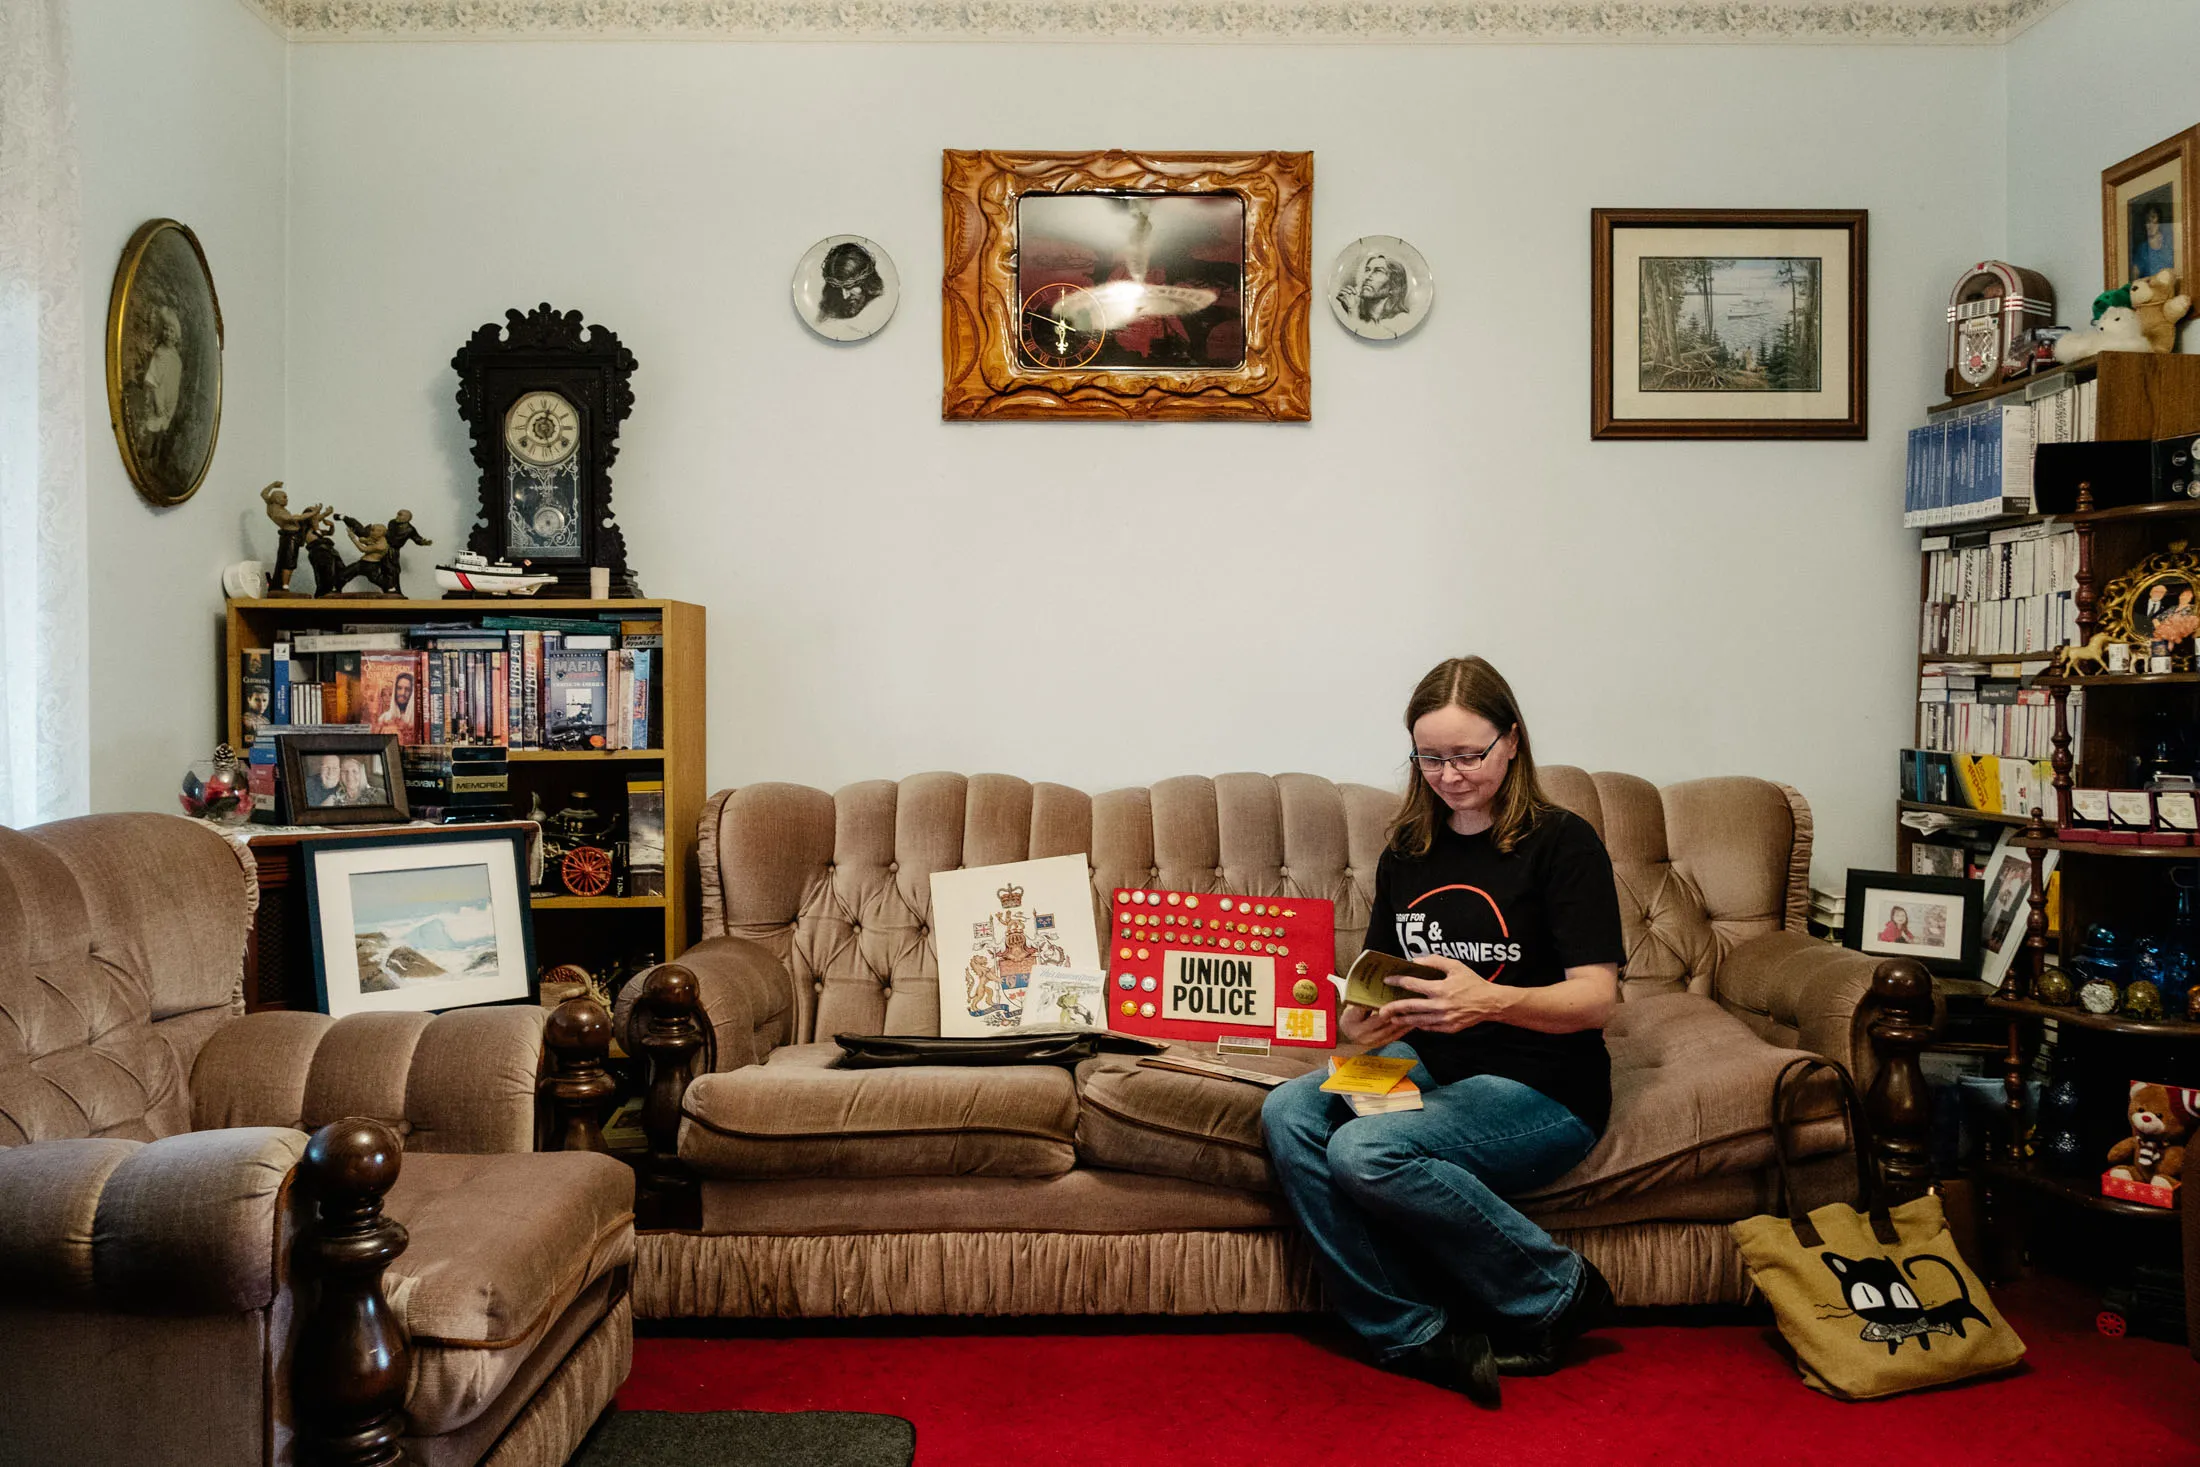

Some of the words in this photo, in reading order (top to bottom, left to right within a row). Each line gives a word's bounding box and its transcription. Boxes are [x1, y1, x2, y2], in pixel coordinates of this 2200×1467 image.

[554, 660, 602, 673] MAFIA
[455, 782, 505, 790] MEMOREX
[1410, 913, 1426, 921] FOR
[1428, 921, 1443, 941] &
[1430, 942, 1521, 962] FAIRNESS
[1180, 957, 1253, 988] UNION
[1173, 985, 1257, 1015] POLICE
